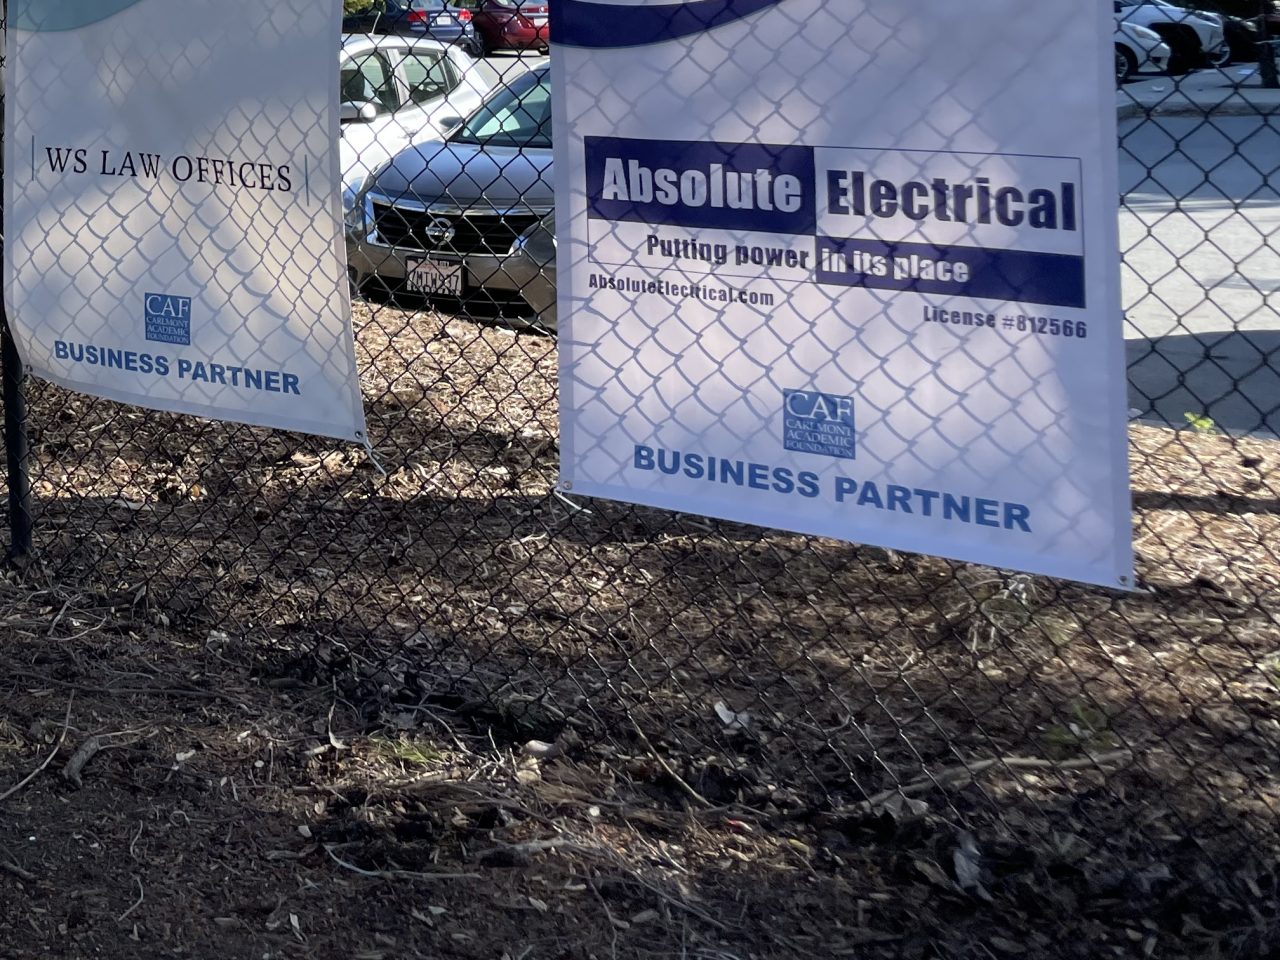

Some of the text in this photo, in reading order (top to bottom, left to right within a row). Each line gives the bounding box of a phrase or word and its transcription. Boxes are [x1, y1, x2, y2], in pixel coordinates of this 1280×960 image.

[45, 147, 292, 192] WS LAW OFFICES
[602, 157, 1077, 232] Absolute Electrical
[647, 234, 969, 283] Putting power in its place
[146, 295, 189, 317] CAF
[589, 273, 774, 307] AbsoluteElectrical.com
[923, 305, 1087, 339] License #812566
[55, 341, 301, 395] BUSINESS PARTNER
[786, 392, 852, 422] CAF
[787, 429, 851, 447] ACADEMIC
[634, 445, 1032, 533] BUSINESS PARTNER
